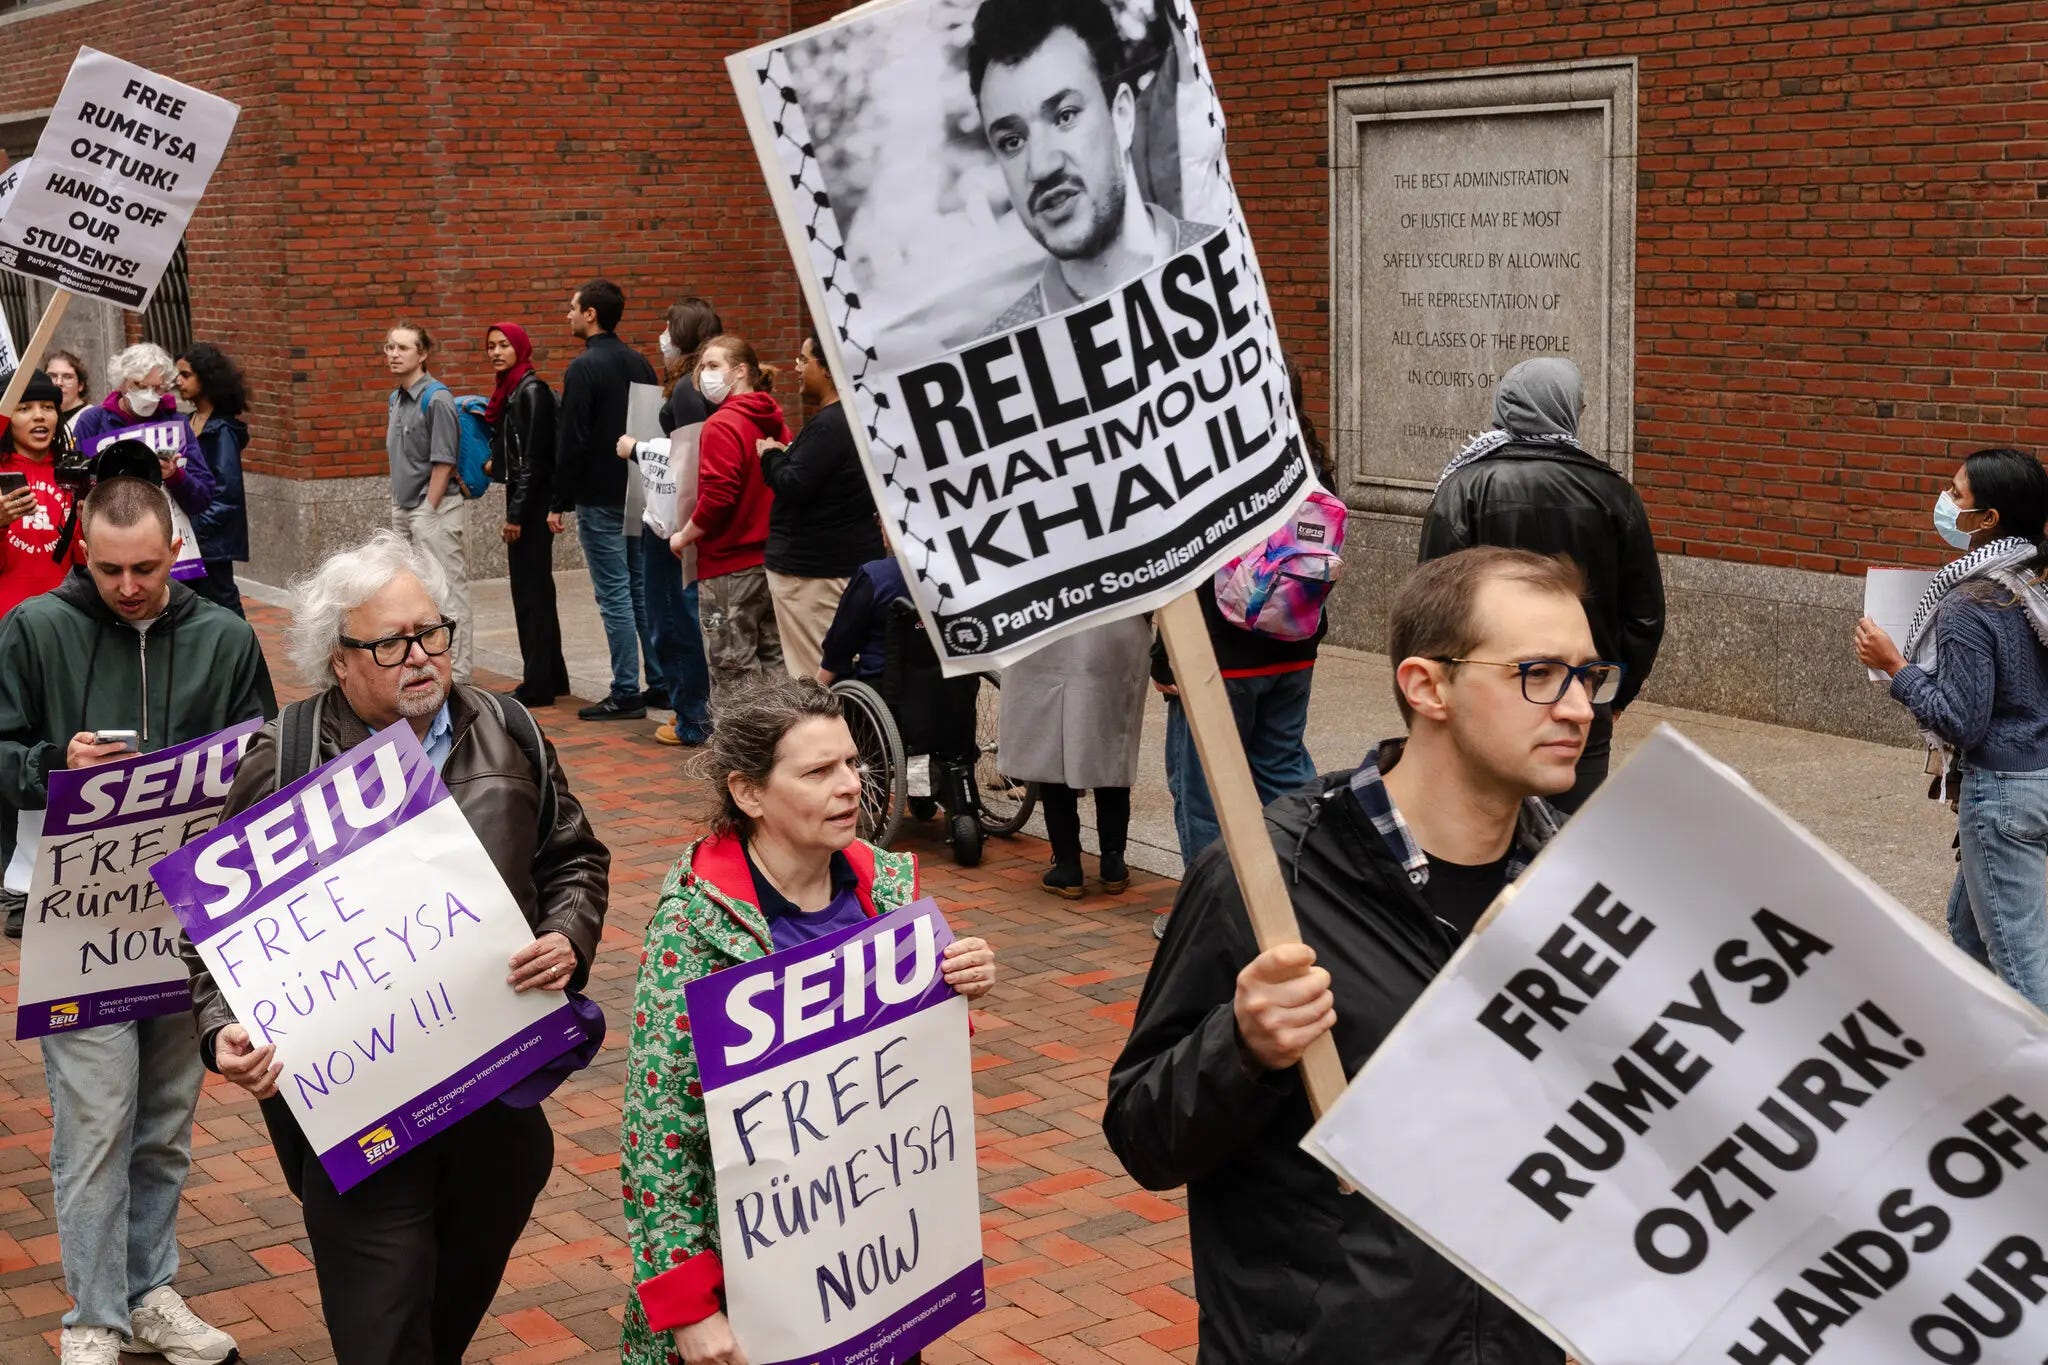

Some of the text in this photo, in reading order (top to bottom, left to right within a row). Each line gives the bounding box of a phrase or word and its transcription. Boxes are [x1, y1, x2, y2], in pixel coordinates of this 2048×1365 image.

[77, 101, 197, 164] RUMEYSA
[122, 79, 187, 121] FREE
[45, 173, 167, 228] HANDS OFF
[70, 137, 179, 192] OZTURK!
[1394, 169, 1569, 189] THE BEST ADMINISTRATION
[22, 226, 141, 278] STUDENTS!
[68, 211, 120, 244] OUR
[1400, 211, 1562, 229] OF JUSTICE MAY BE MOST
[27, 255, 138, 297] Party for Socialism and Liberation
[1383, 252, 1581, 269] SAFELY SECURED BY ALLOWING
[1400, 292, 1561, 311] THE REPRESENTATION OF
[897, 229, 1251, 471] RELEASE
[1392, 331, 1570, 352] ALL CLASSES OF THE PEOPLE
[1408, 370, 1495, 389] IN COURTS OF
[929, 336, 1263, 519] MAHMOUD
[946, 379, 1279, 586] KHALIL!
[992, 598, 1054, 637] Party
[1058, 583, 1095, 609] for
[1099, 536, 1203, 594] Socialism
[1204, 511, 1240, 545] and
[1238, 456, 1304, 521] Liberation
[67, 732, 251, 826] SEIU
[47, 811, 221, 886] FREE
[193, 741, 408, 921] SEIU
[37, 881, 166, 923] RÜME
[216, 876, 365, 988] FREE
[99, 988, 190, 1008] Service Employees Internati
[252, 892, 481, 1044] RÜMEYSA
[723, 913, 936, 1068] SEIU
[1475, 881, 1657, 1062] FREE
[49, 1013, 79, 1026] SEIU
[117, 1004, 132, 1013] CLC
[293, 982, 457, 1110] NOW !!!
[411, 1034, 543, 1120] Service Employees International Union
[1506, 907, 1835, 1223] RUMEYSA
[436, 1103, 453, 1117] CLC
[732, 1035, 919, 1167] FREE
[1634, 999, 1926, 1275] OZTURK!
[365, 1137, 397, 1163] SEIU
[735, 1104, 955, 1260] RÜMEYSA
[815, 1207, 921, 1324] NOW
[1725, 1094, 2048, 1365] HANDS OFF
[844, 1291, 958, 1365] Service Employees International Union
[1910, 1235, 2048, 1365] OUR
